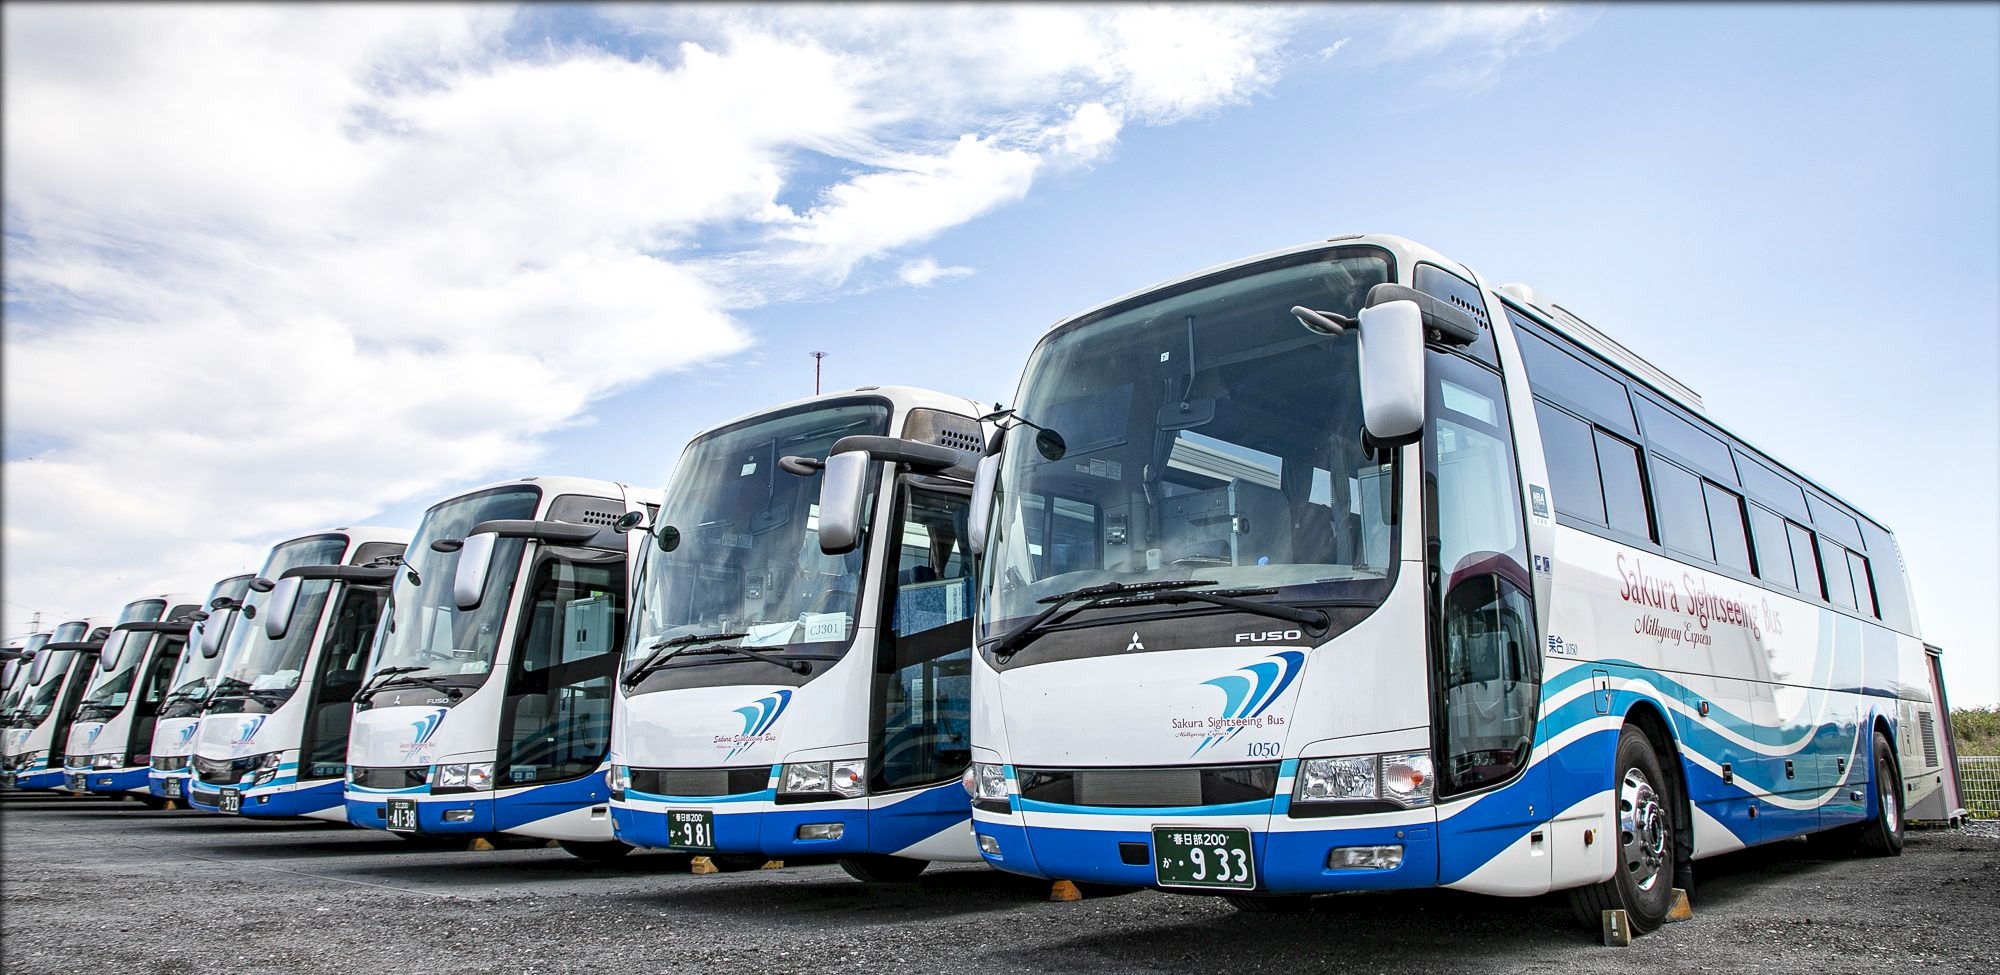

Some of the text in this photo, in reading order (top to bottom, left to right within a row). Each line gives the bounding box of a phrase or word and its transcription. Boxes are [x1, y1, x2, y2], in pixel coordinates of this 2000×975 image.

[1616, 552, 1783, 641] Sakura Sightseeing Bus
[810, 623, 839, 636] CJ301
[1235, 629, 1301, 643] FUSO
[1634, 614, 1712, 649] Milkyway Express
[1548, 635, 1564, 654] 乗合
[1172, 714, 1285, 729] Sakura Sightseeing Bus
[1246, 742, 1280, 757] 1050
[1173, 833, 1227, 846] 春日部200
[1162, 857, 1172, 869] か
